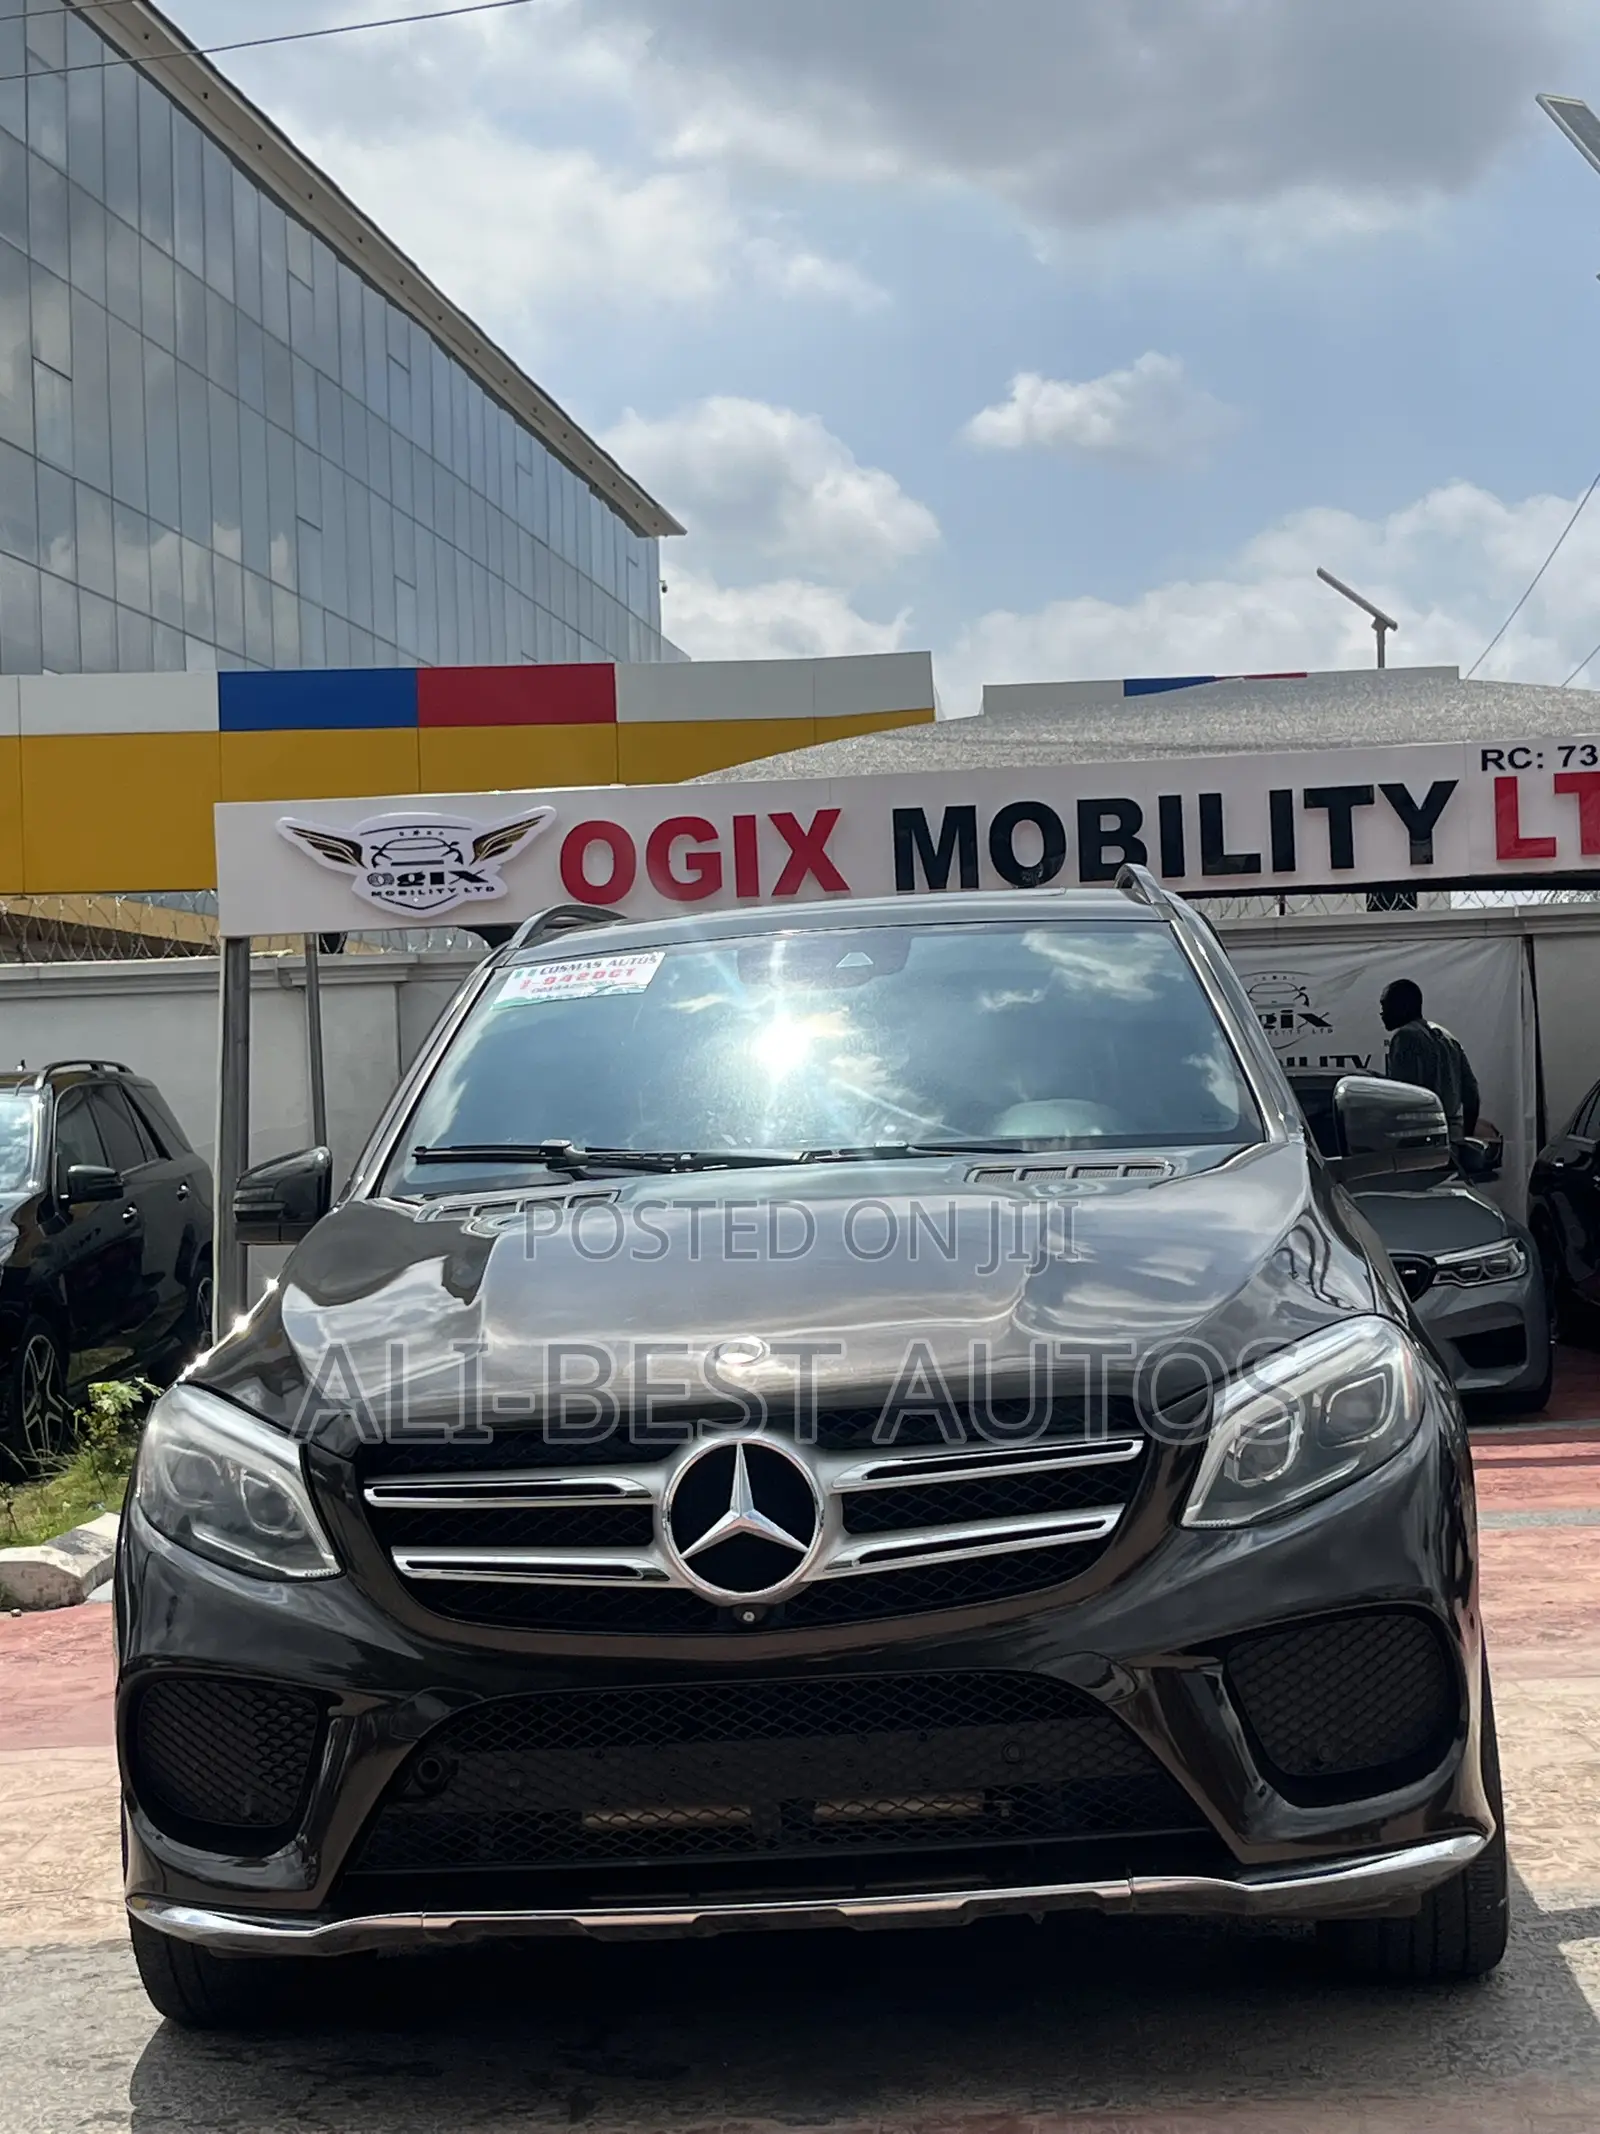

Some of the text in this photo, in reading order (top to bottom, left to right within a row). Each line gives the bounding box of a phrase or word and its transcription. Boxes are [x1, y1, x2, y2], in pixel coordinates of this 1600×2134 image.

[1481, 747, 1544, 771] RC:
[559, 809, 850, 904] OGIX
[893, 780, 1459, 891] MOBILITY
[371, 887, 457, 897] MOBILITY
